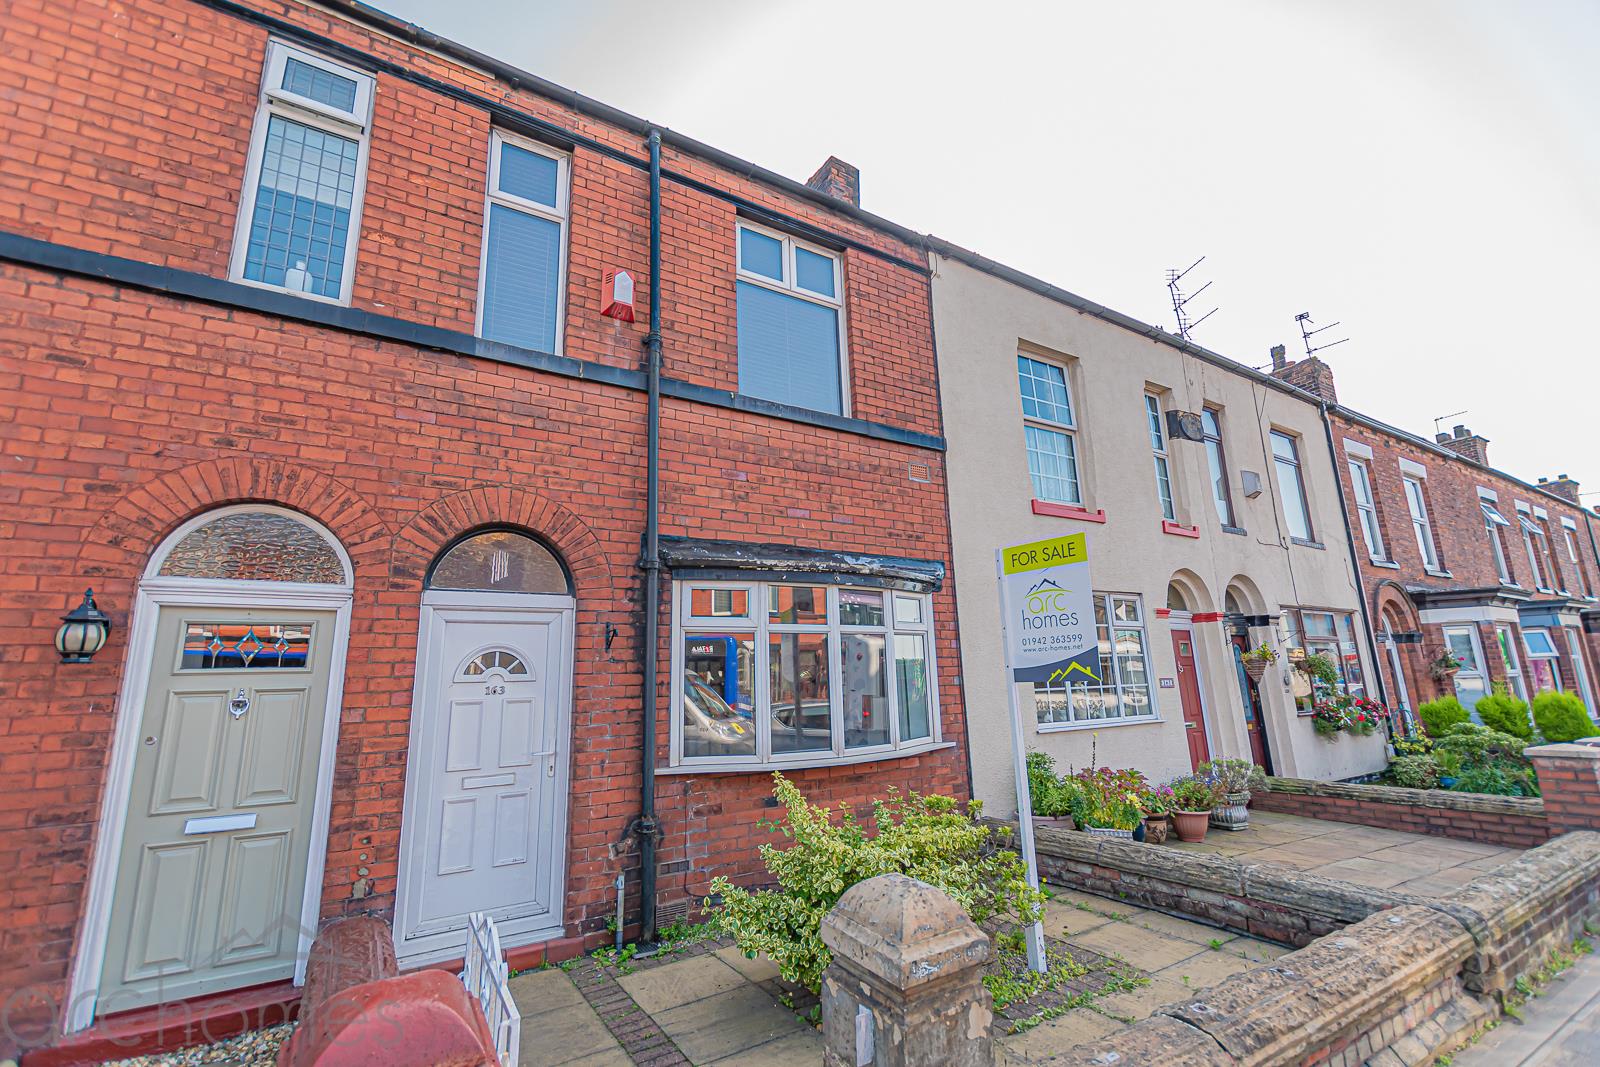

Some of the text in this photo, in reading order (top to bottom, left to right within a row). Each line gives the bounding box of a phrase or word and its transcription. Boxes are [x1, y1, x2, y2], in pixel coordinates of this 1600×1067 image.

[1011, 541, 1076, 568] FOR SALE
[1028, 592, 1067, 614] arc
[1021, 609, 1079, 630] homes
[1022, 633, 1083, 646] 01942 363599
[484, 685, 506, 696] 163
